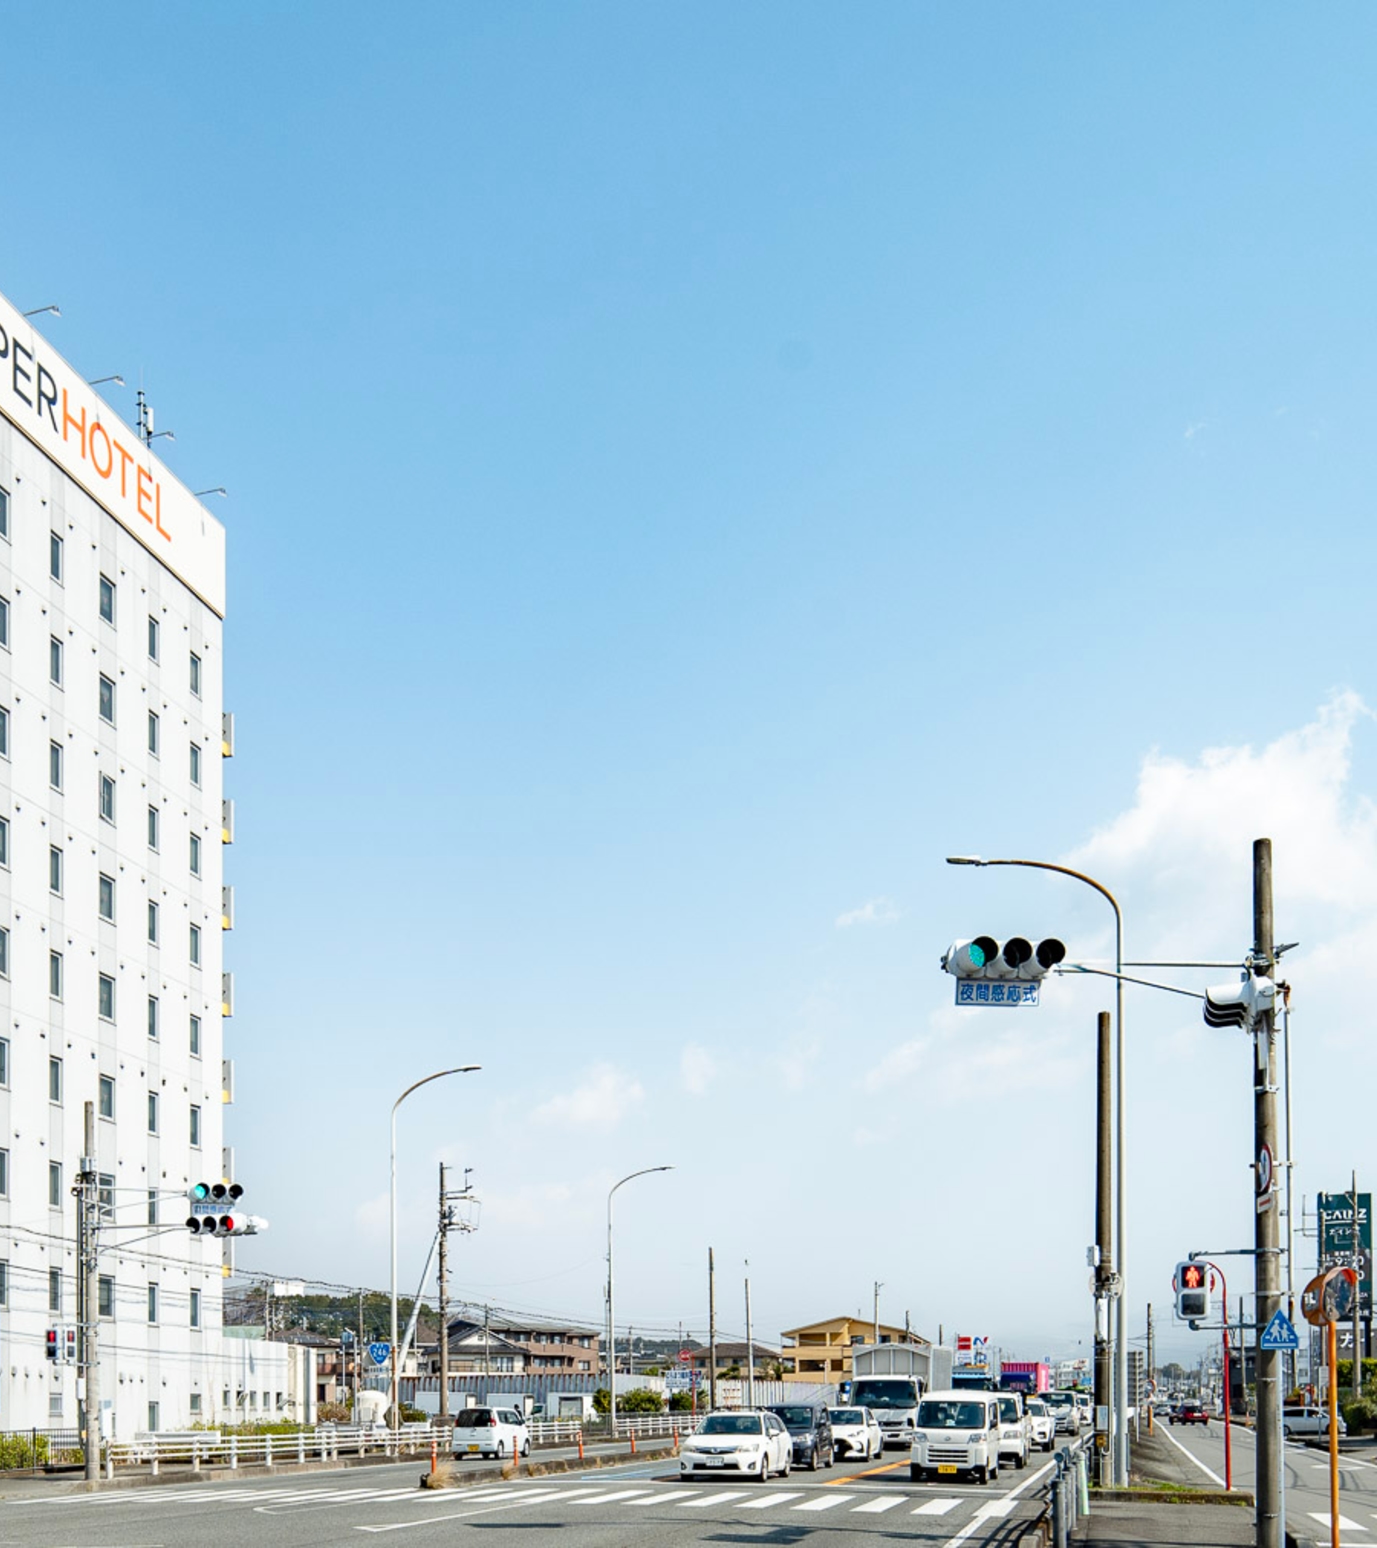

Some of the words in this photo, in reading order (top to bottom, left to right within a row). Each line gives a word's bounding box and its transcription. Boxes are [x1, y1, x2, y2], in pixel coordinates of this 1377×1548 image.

[960, 983, 1037, 1003] 夜間感応式
[373, 1348, 387, 1357] 246
